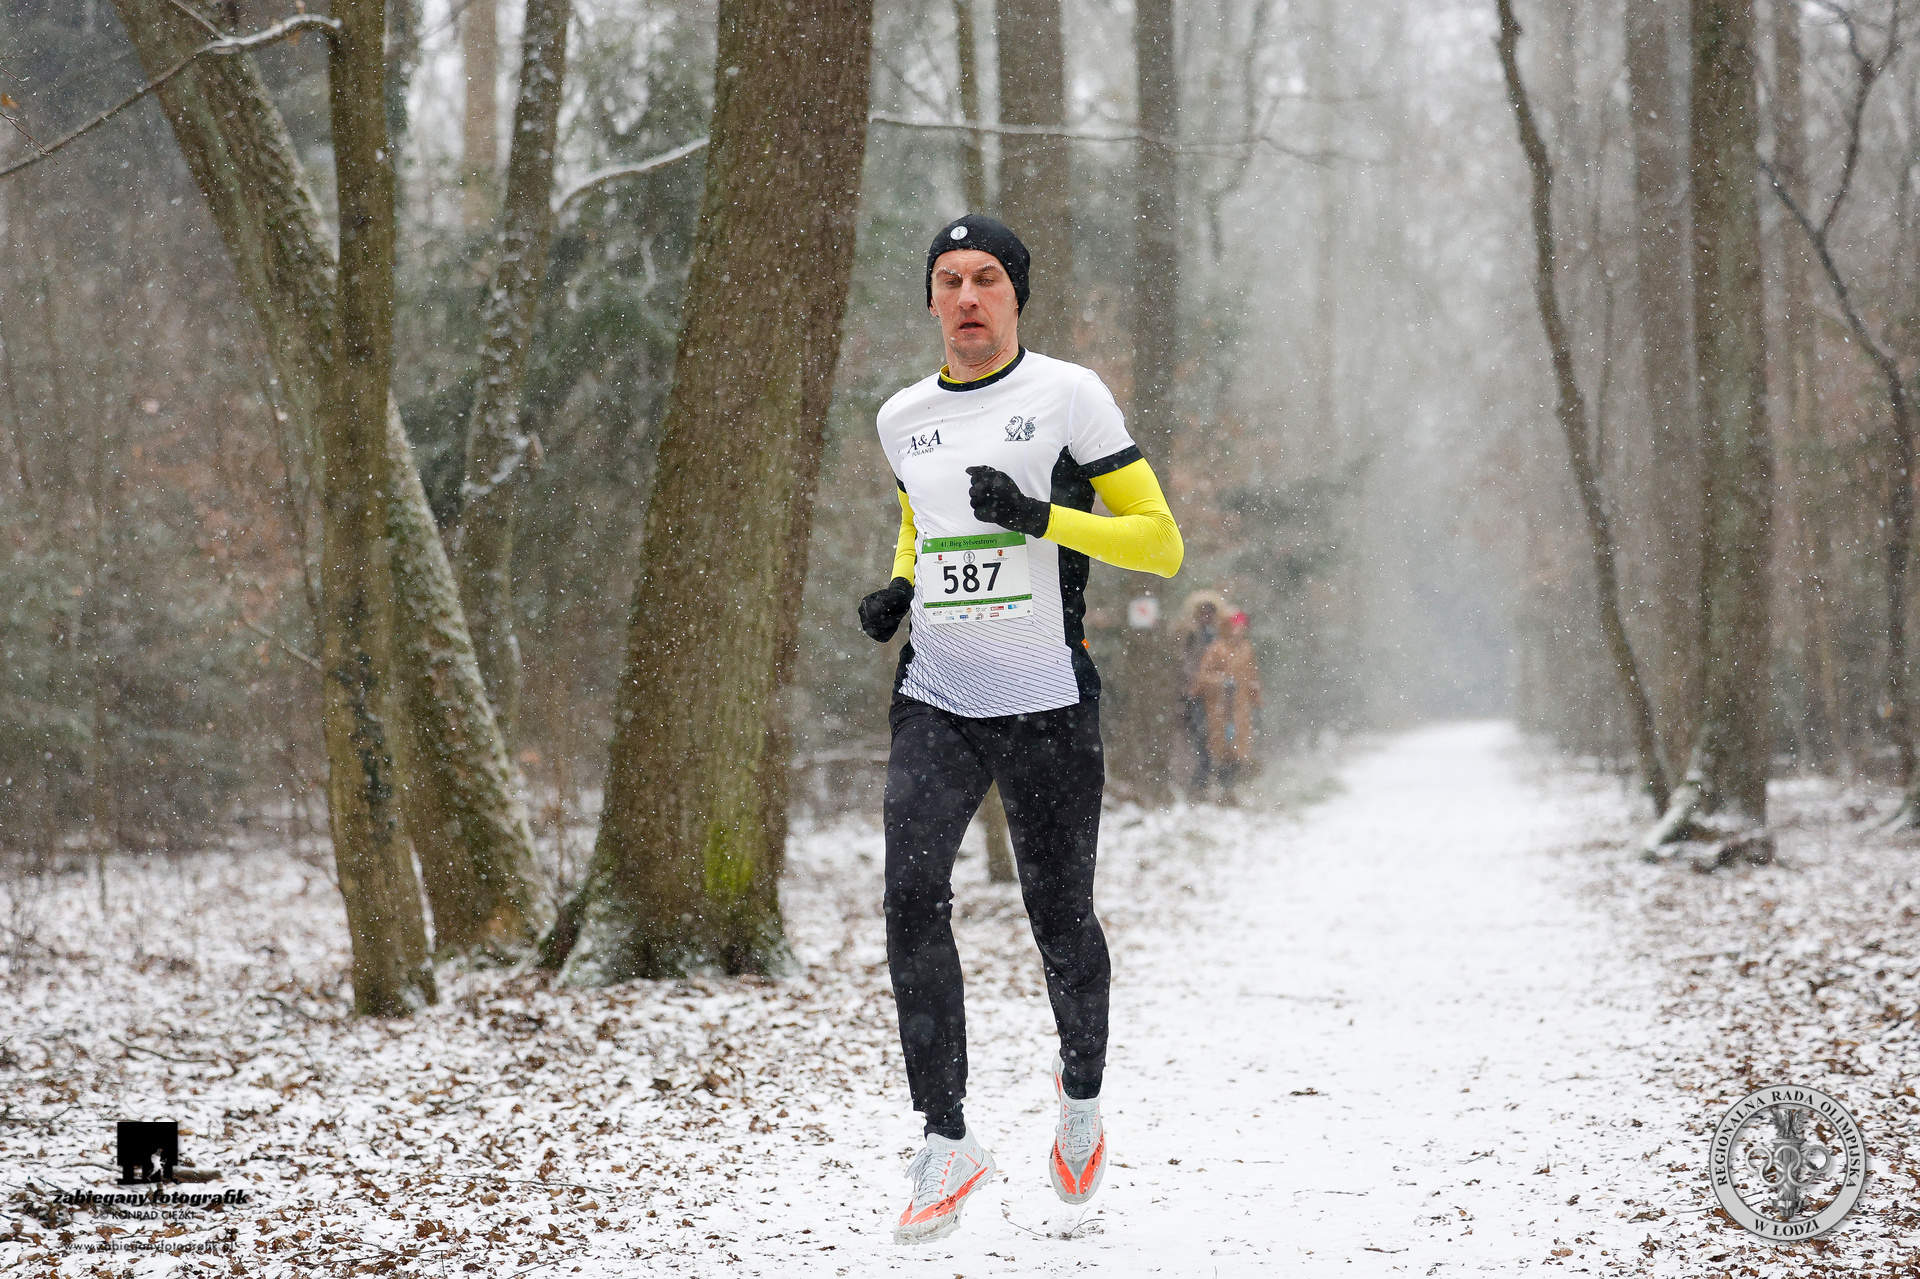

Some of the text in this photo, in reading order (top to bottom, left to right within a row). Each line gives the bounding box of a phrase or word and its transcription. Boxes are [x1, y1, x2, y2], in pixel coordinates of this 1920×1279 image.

[907, 428, 942, 454] A&A
[950, 540, 961, 548] Bieg
[943, 562, 1002, 594] 587
